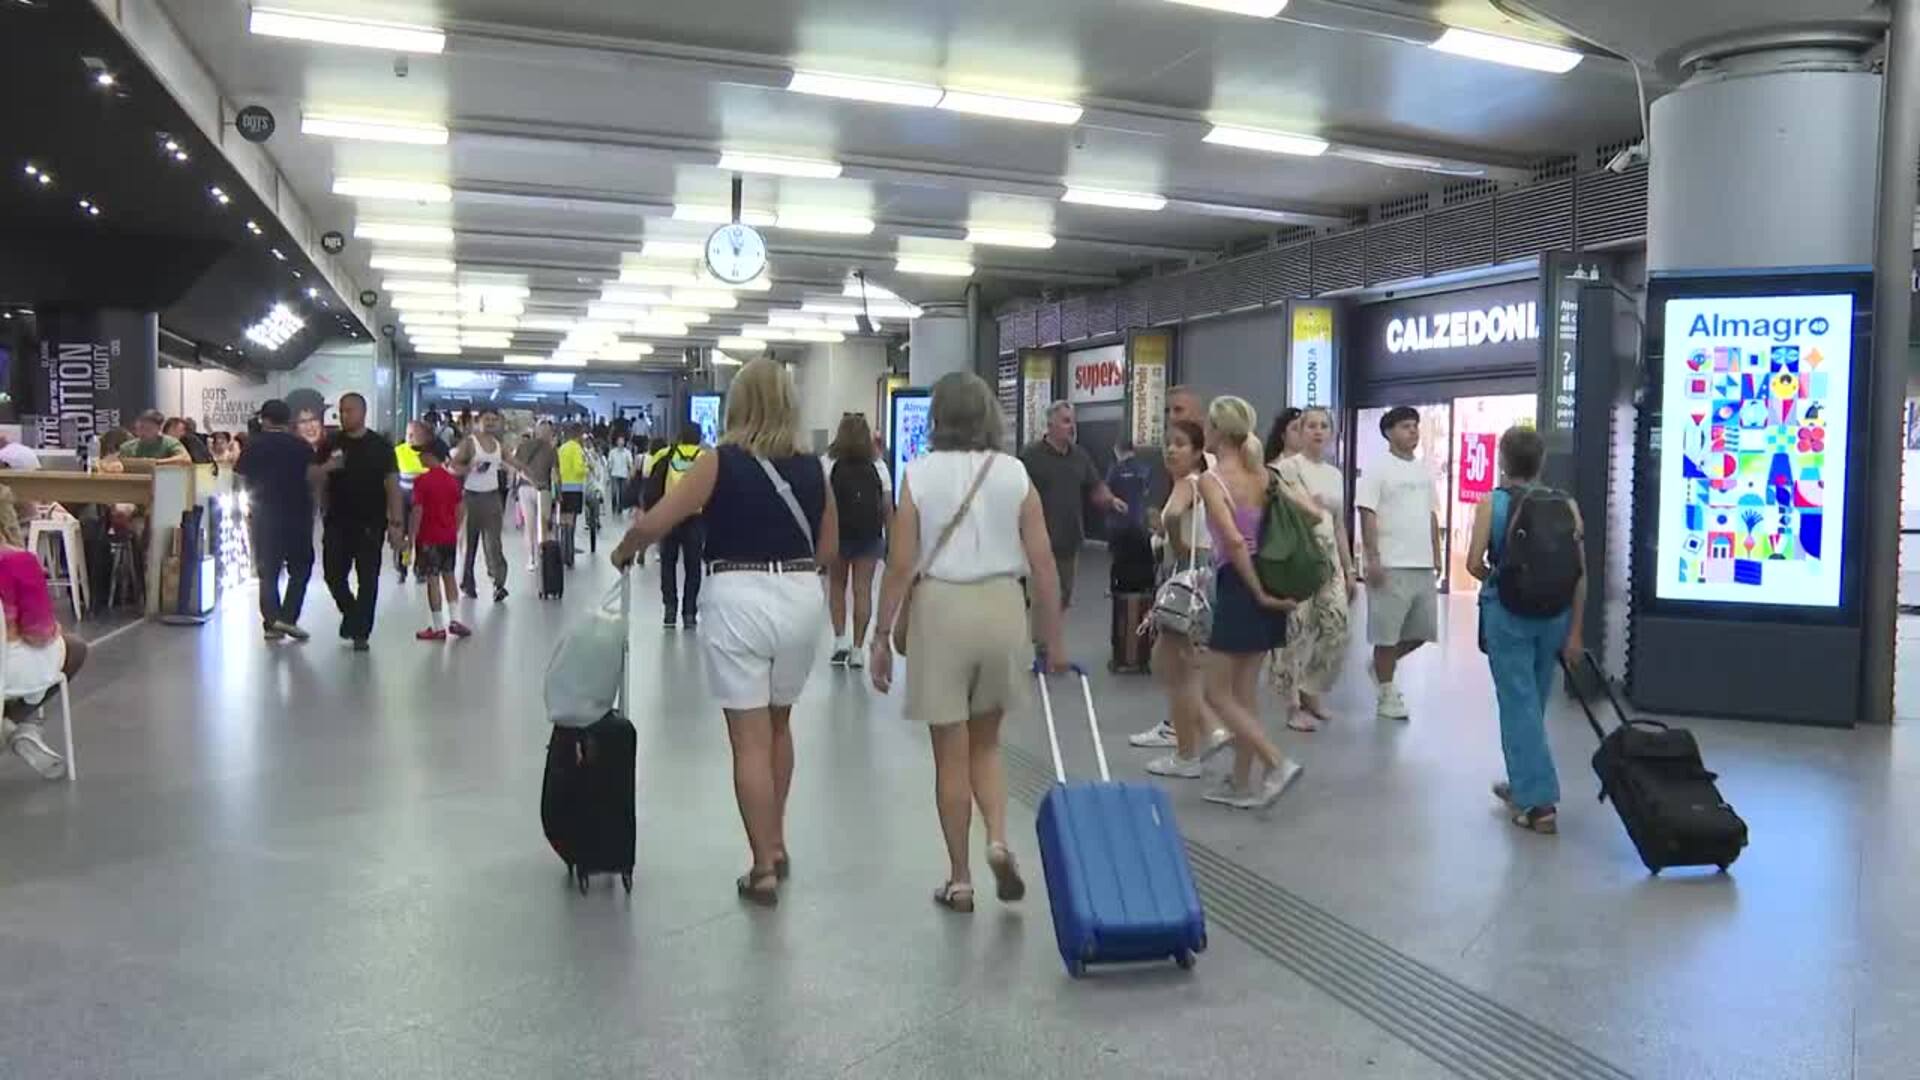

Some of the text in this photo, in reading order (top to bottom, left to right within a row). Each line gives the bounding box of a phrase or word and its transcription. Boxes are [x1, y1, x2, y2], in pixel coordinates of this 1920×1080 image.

[1386, 302, 1540, 354] CALZEDONI
[93, 344, 110, 390] QUALITY
[1075, 359, 1126, 395] supers
[1308, 347, 1317, 408] ZEDONIA
